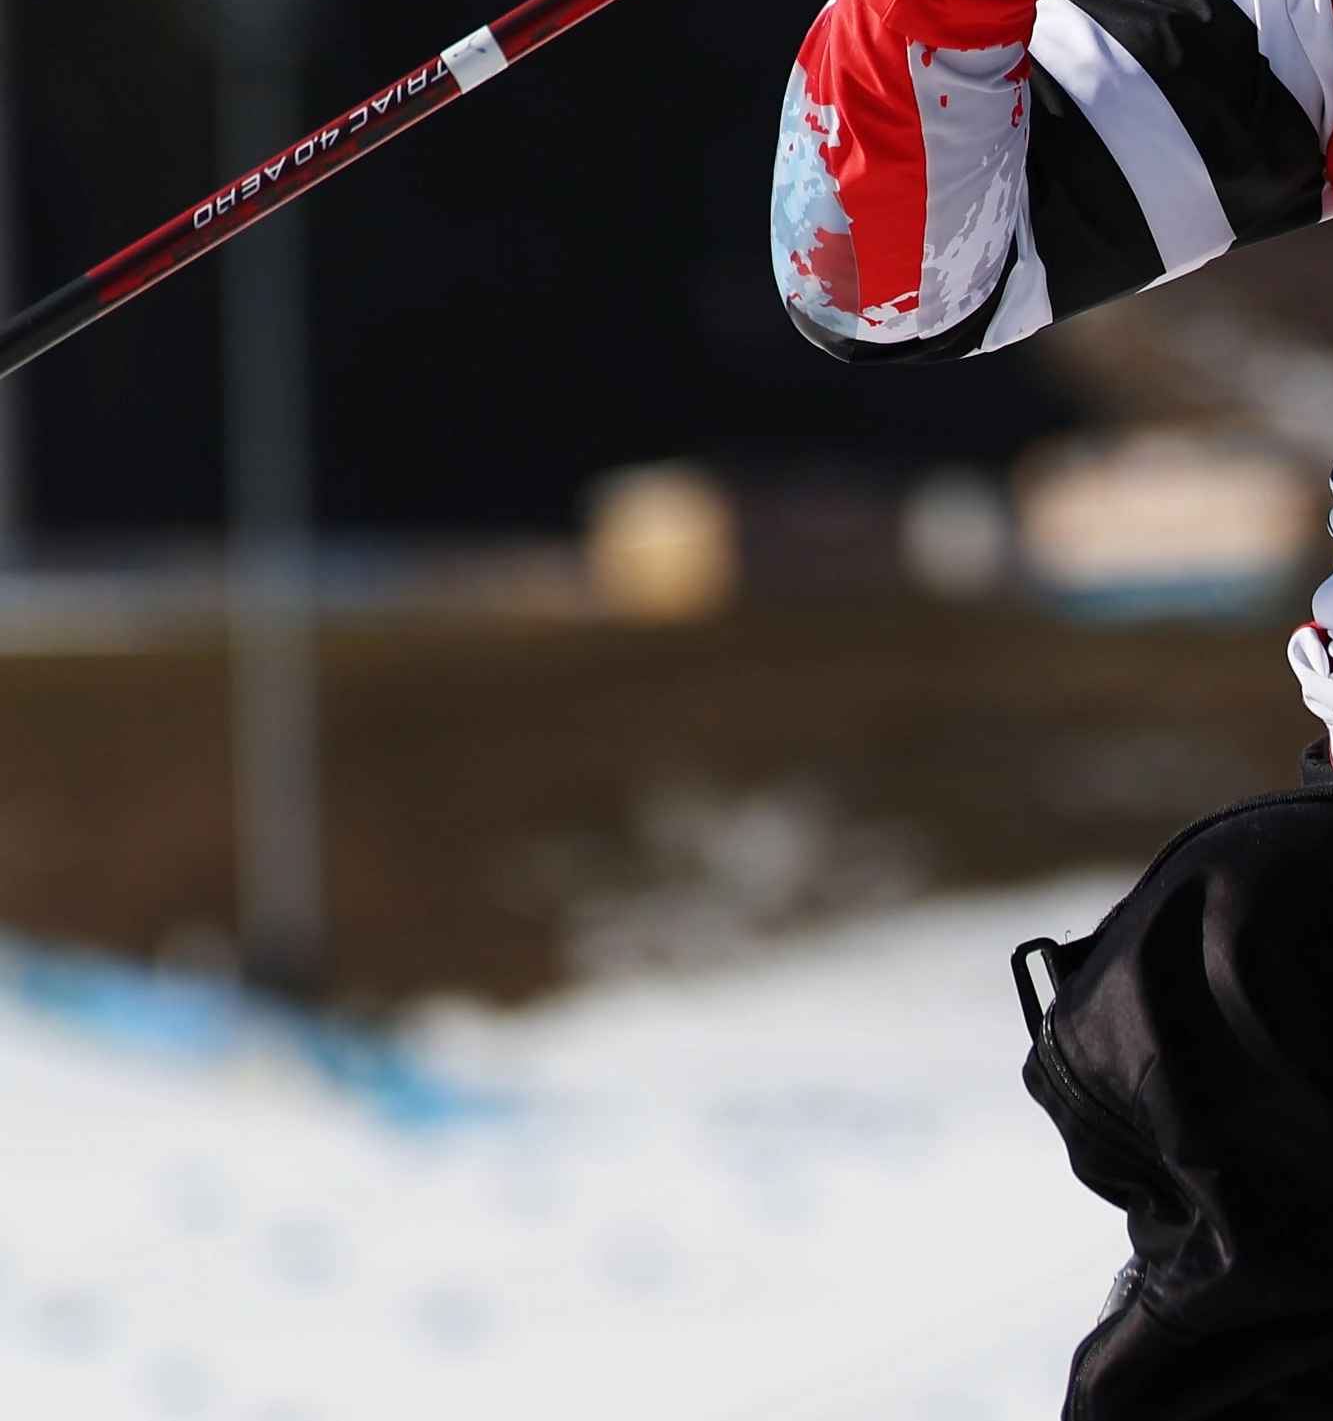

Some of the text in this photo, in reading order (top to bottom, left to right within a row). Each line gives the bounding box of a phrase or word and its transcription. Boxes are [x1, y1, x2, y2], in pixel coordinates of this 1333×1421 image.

[193, 58, 449, 230] TRIAC 4.0 AERO
